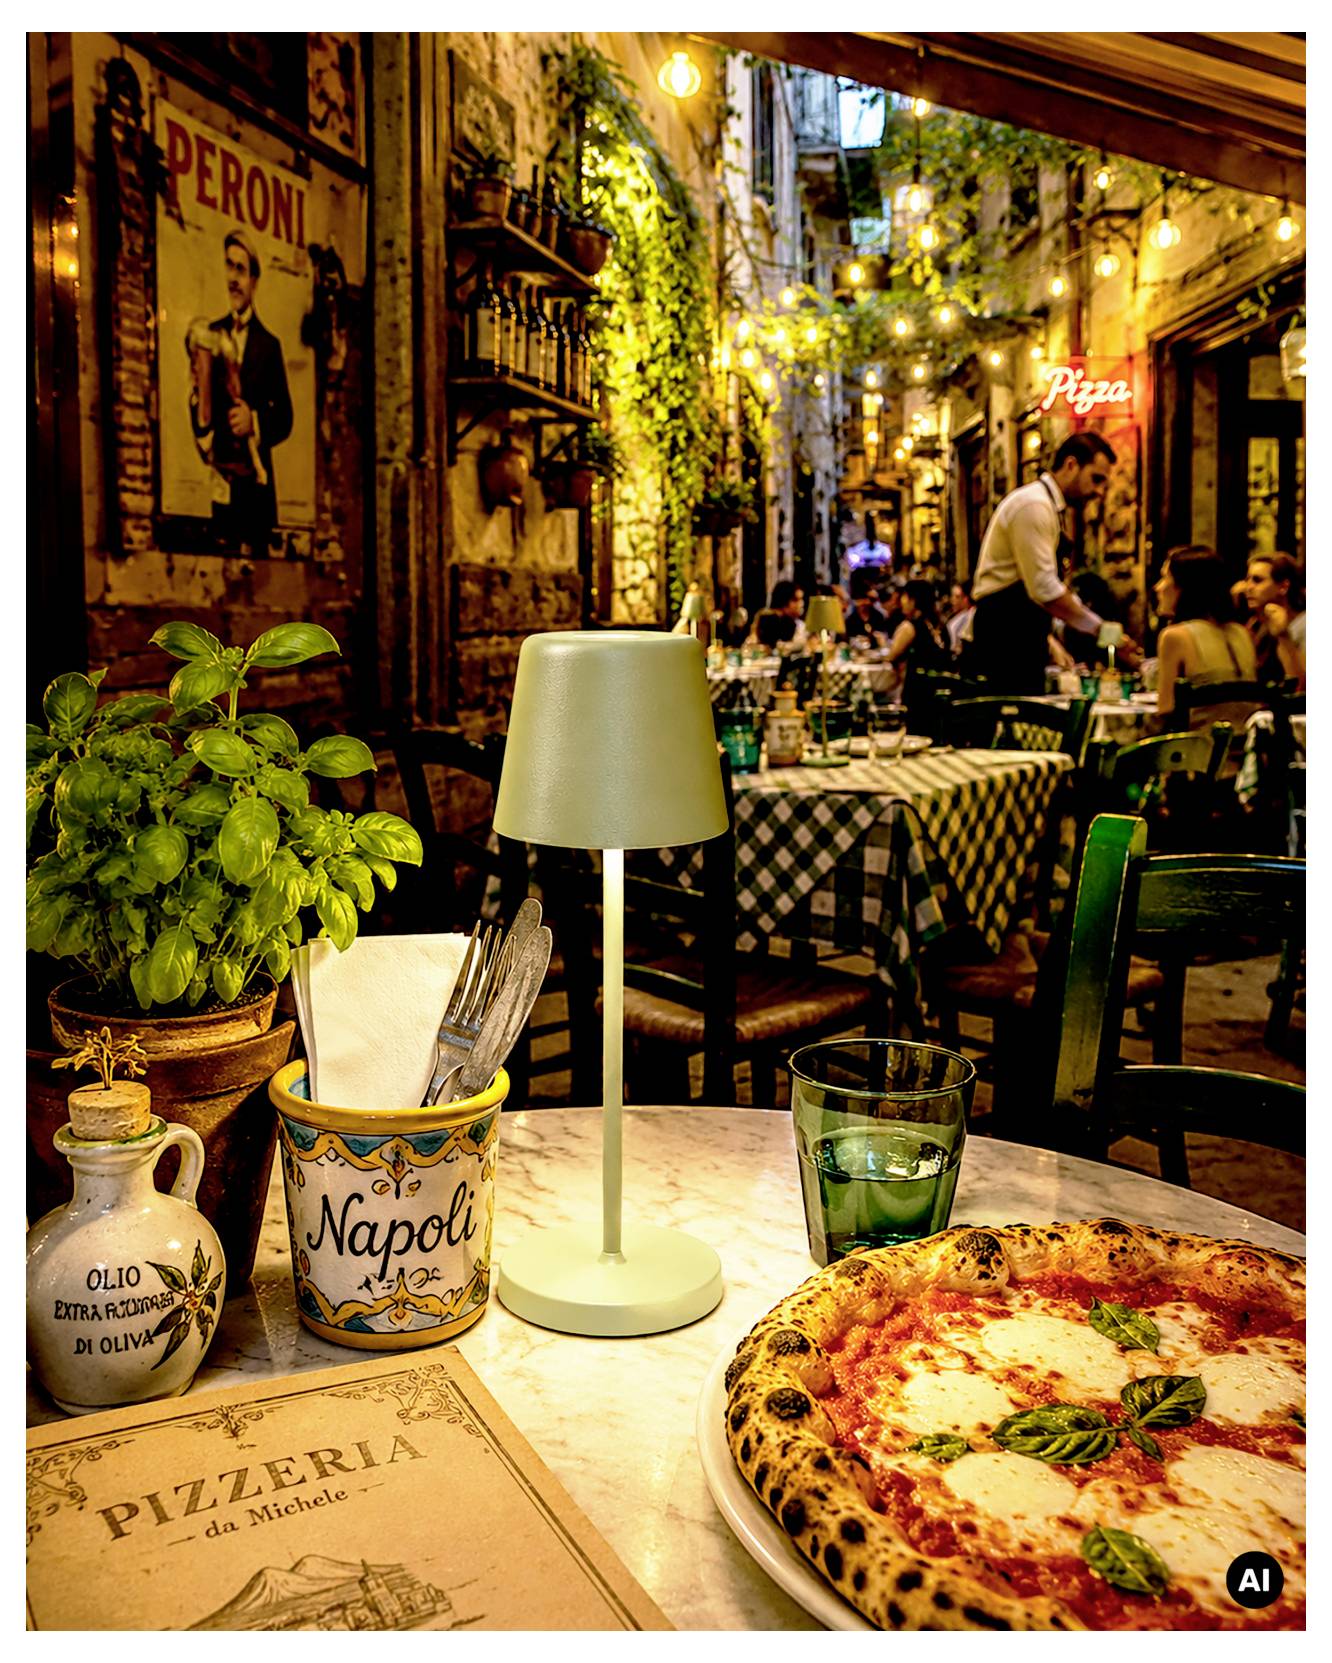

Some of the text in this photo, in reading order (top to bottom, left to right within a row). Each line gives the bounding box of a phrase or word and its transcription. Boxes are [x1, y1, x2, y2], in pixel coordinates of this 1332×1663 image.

[165, 117, 305, 249] PERONI
[1042, 366, 1133, 414] Pizza
[306, 1181, 477, 1282] Napoli
[86, 1265, 141, 1291] OLIO
[54, 1299, 102, 1321] EXTRA
[73, 1329, 154, 1355] DI OLIVA
[95, 1433, 428, 1541] PIZZERIA
[205, 1488, 349, 1538] da Michele
